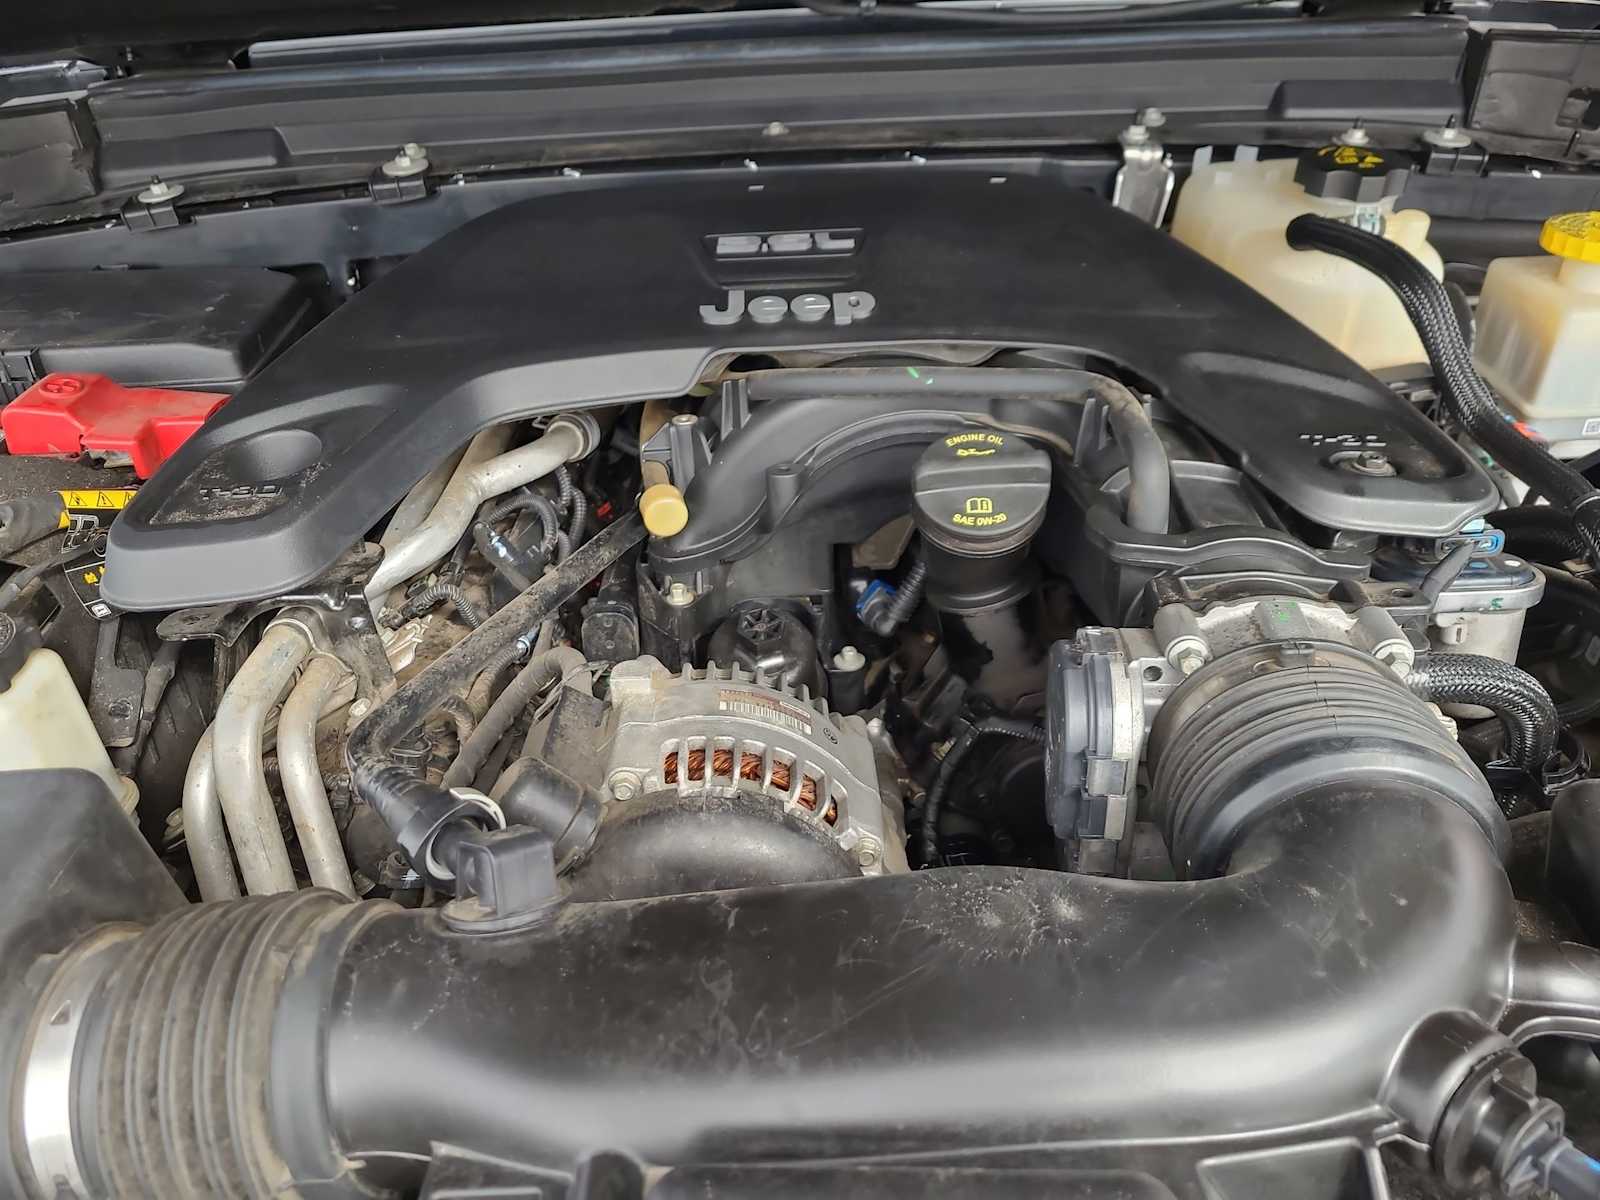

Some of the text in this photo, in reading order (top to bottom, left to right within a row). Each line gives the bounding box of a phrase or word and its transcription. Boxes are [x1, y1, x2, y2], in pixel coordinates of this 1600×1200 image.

[699, 290, 876, 325] Jeep
[946, 434, 1004, 447] ENGINE OIL
[952, 513, 1007, 526] SAE 0W-20
